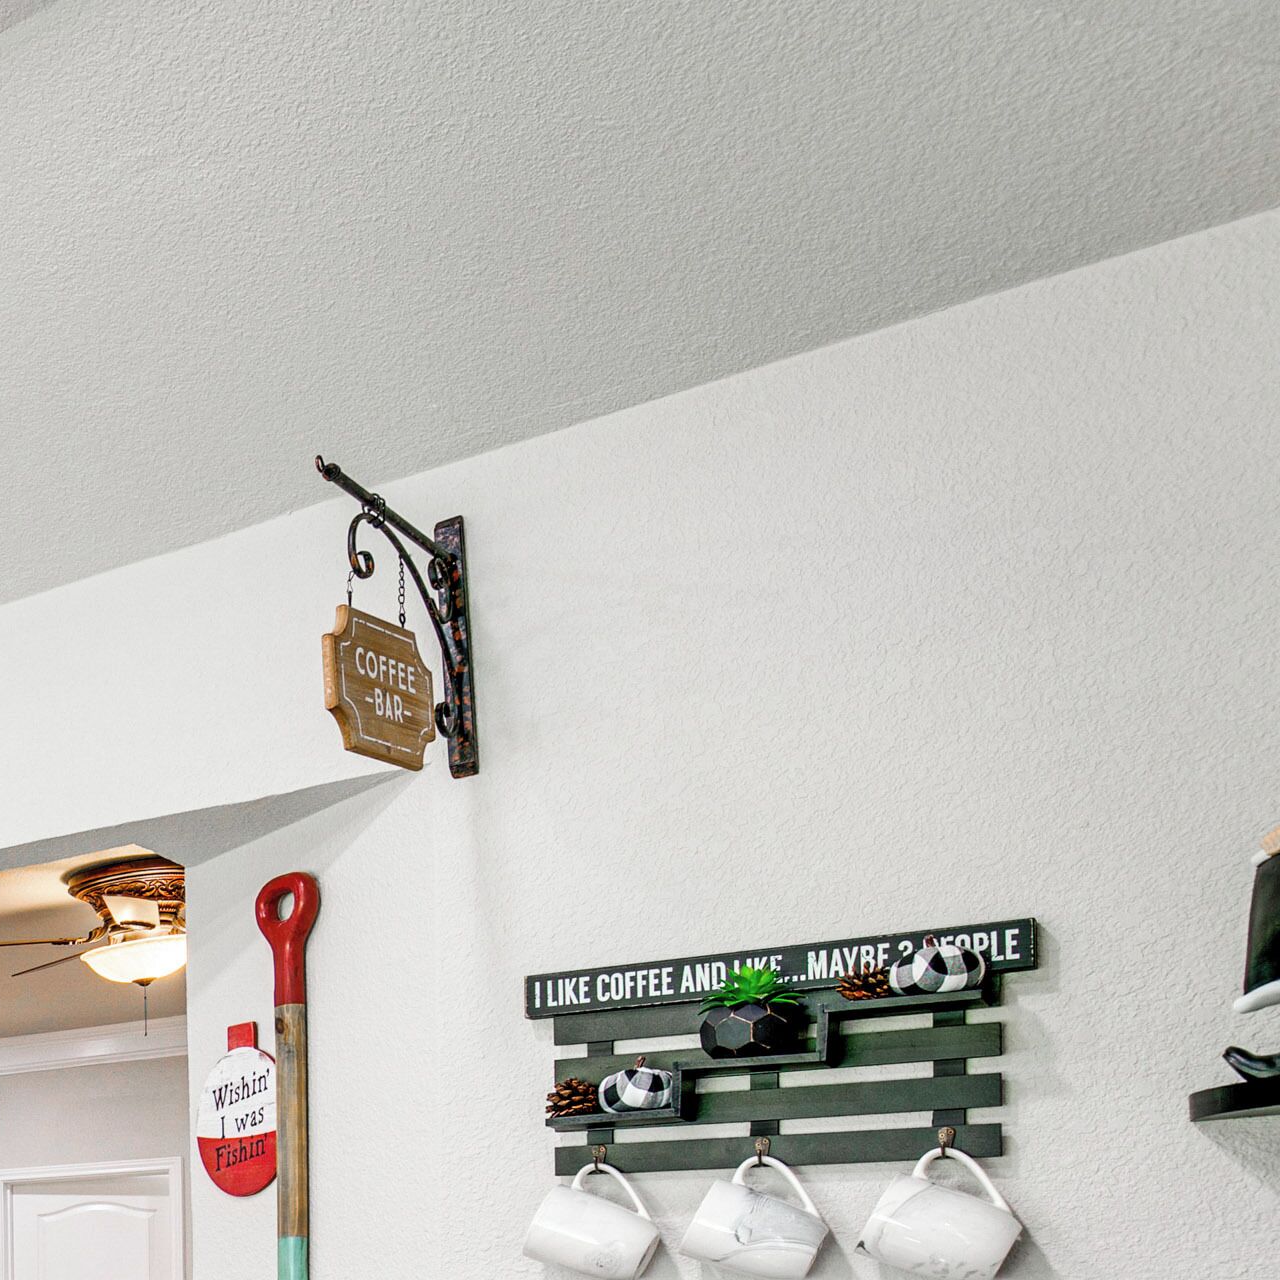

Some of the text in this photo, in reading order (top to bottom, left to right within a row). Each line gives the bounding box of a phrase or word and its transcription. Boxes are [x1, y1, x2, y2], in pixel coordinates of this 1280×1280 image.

[355, 647, 416, 694] COFFEE
[534, 980, 542, 1008] I
[547, 975, 591, 1006] LIKE
[596, 965, 675, 1001] COFFEE
[681, 960, 726, 993] AND
[212, 1068, 270, 1112] Wishin'
[220, 1106, 265, 1140] I was
[215, 1133, 268, 1172] Fishin'
